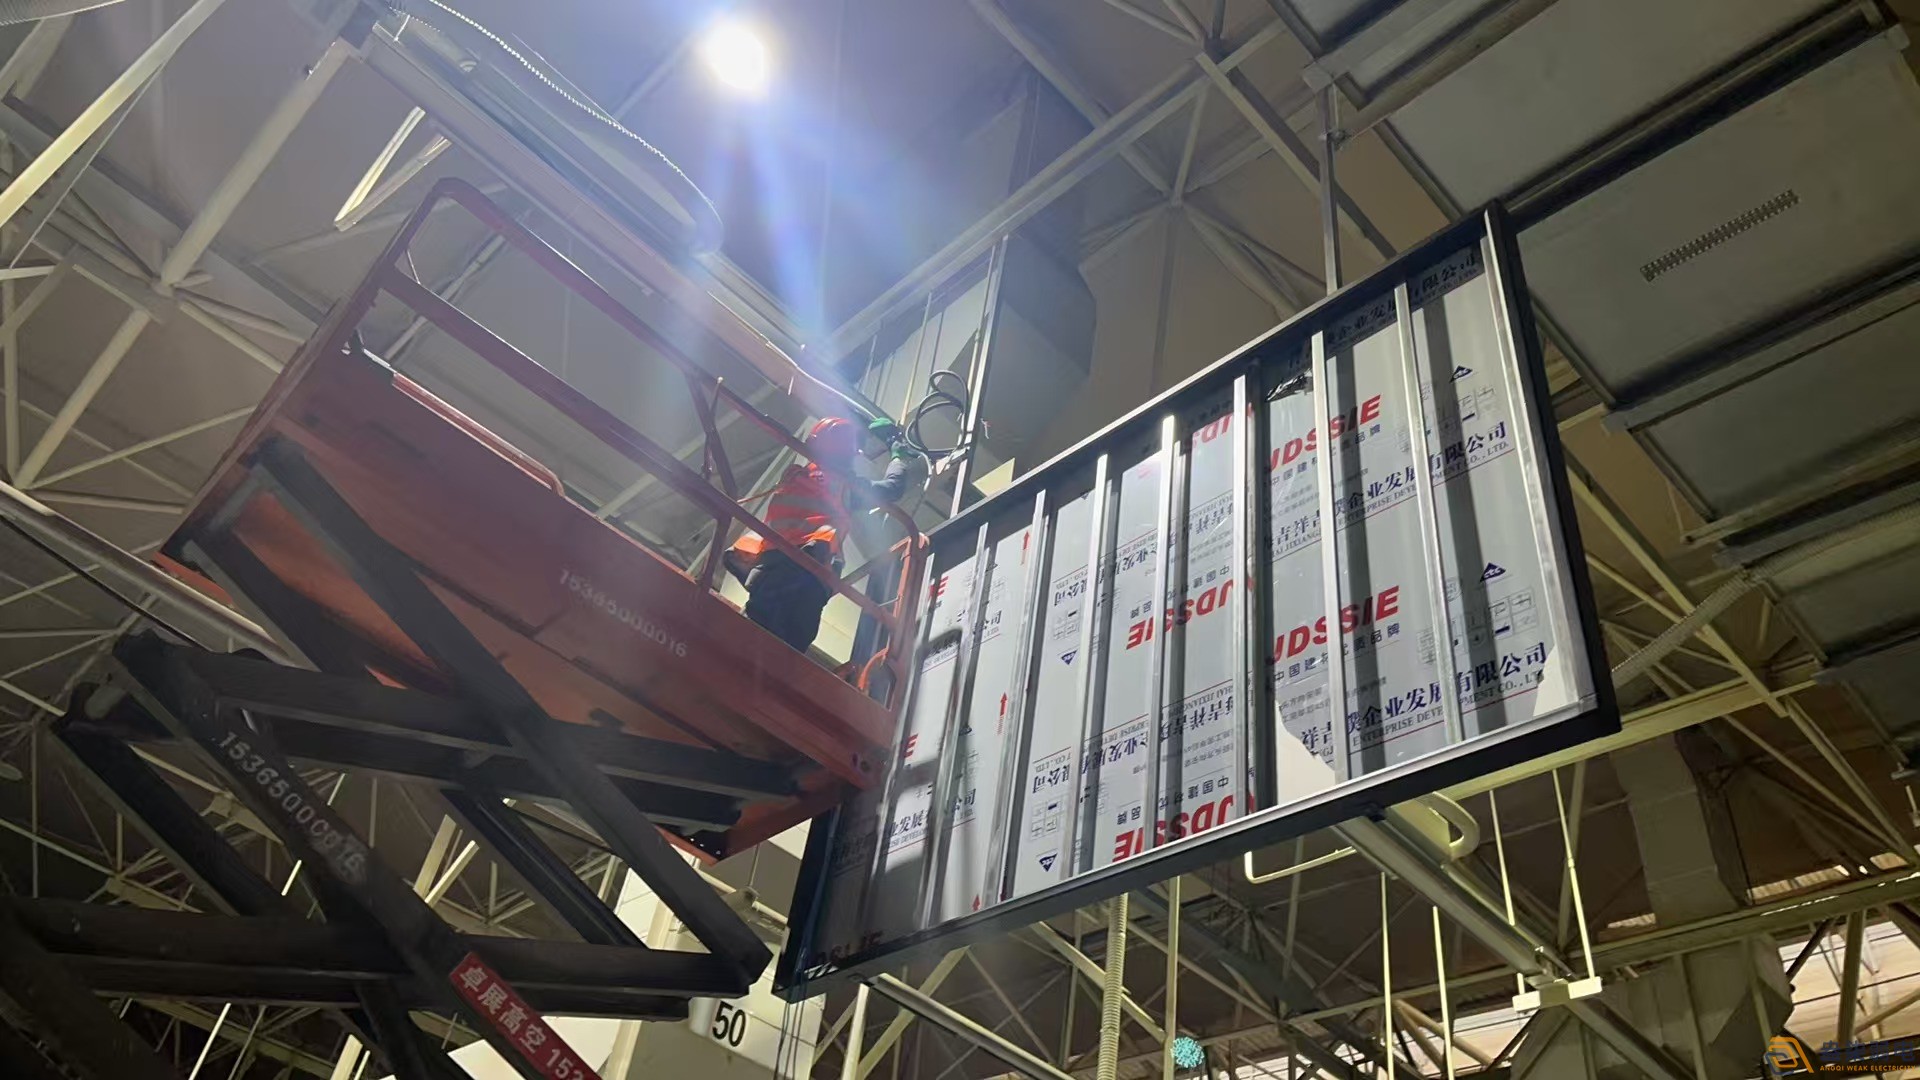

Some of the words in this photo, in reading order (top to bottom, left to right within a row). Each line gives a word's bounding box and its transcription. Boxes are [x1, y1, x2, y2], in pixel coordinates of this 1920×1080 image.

[457, 966, 547, 1055] 卓展高空
[712, 1000, 747, 1048] 50
